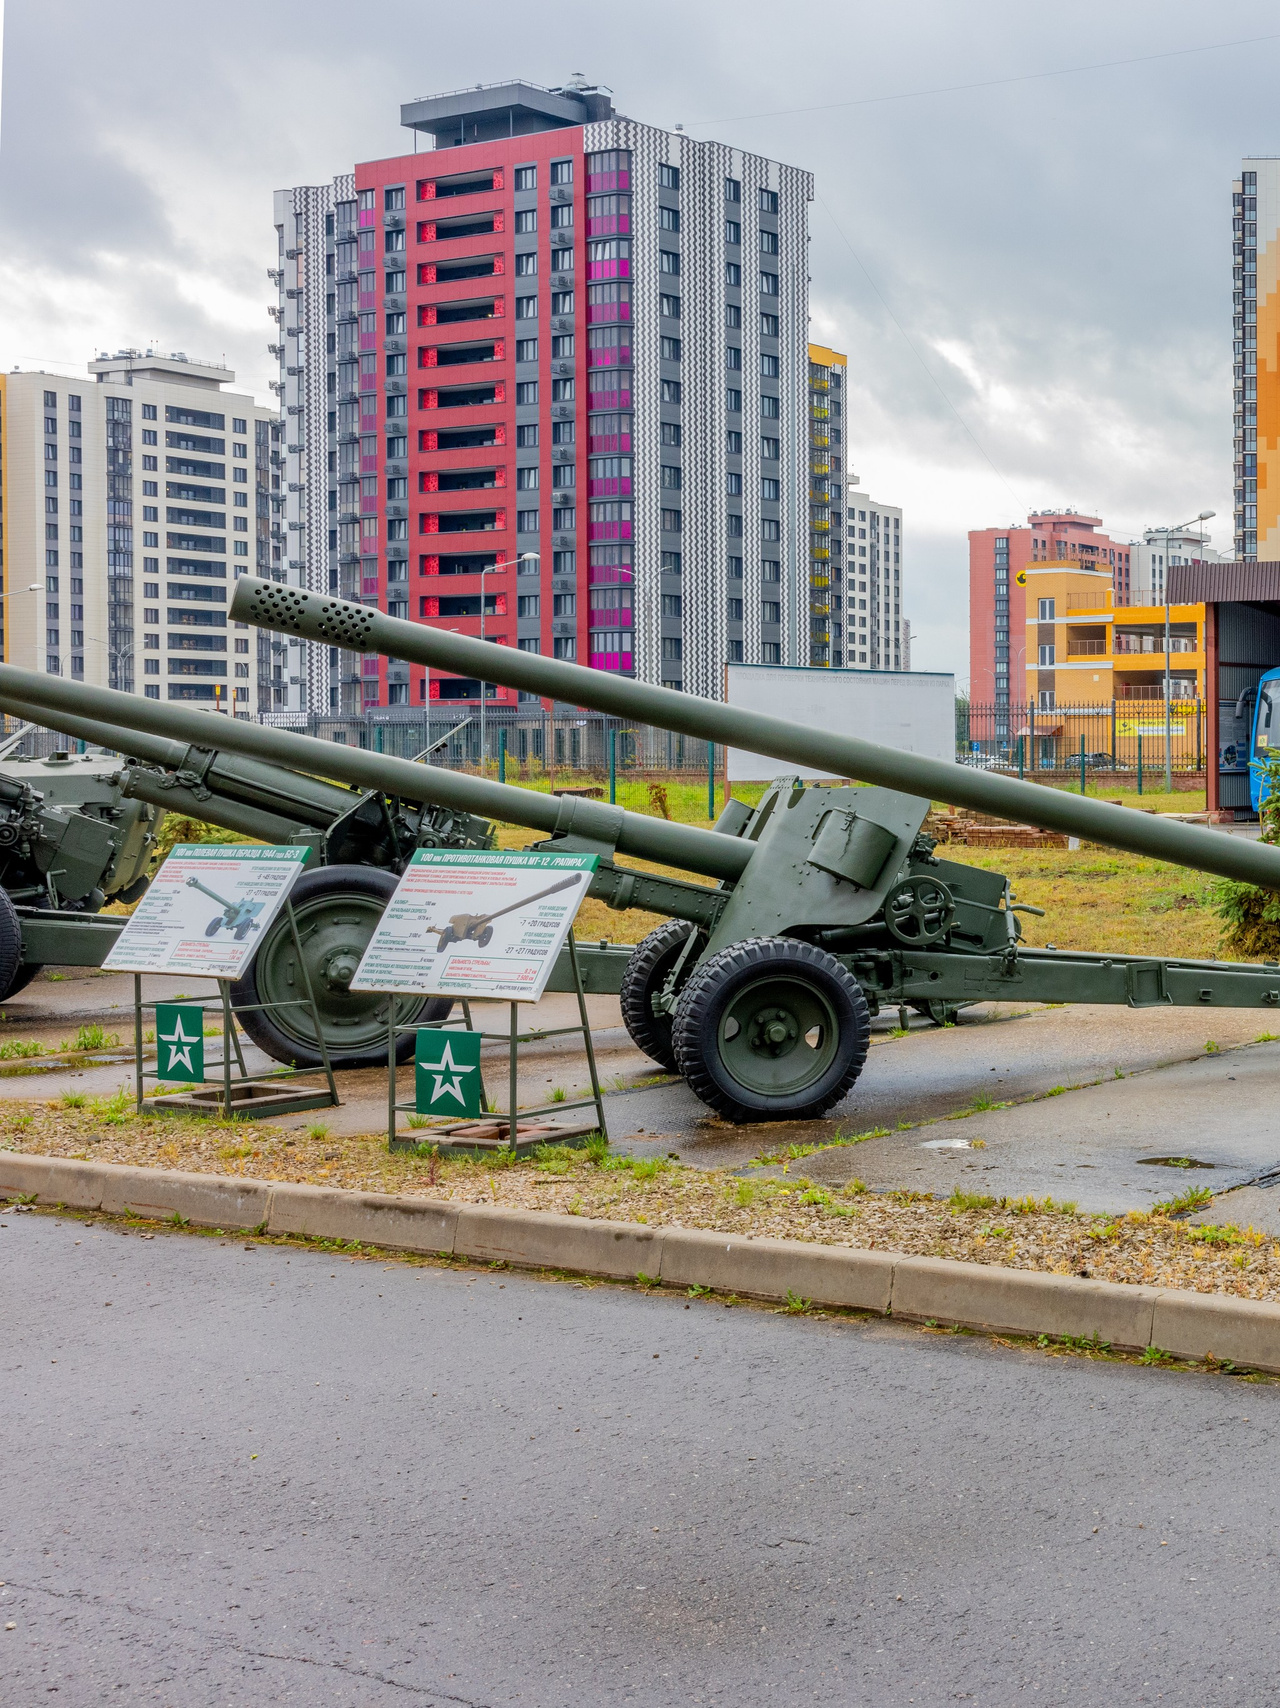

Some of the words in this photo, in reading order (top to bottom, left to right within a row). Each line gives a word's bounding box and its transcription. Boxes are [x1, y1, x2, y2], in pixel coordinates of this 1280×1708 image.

[442, 854, 502, 863] ПРОТИВОТАНКОВАЯ
[504, 856, 527, 864] ПУШКА
[528, 857, 548, 865] МТ-12
